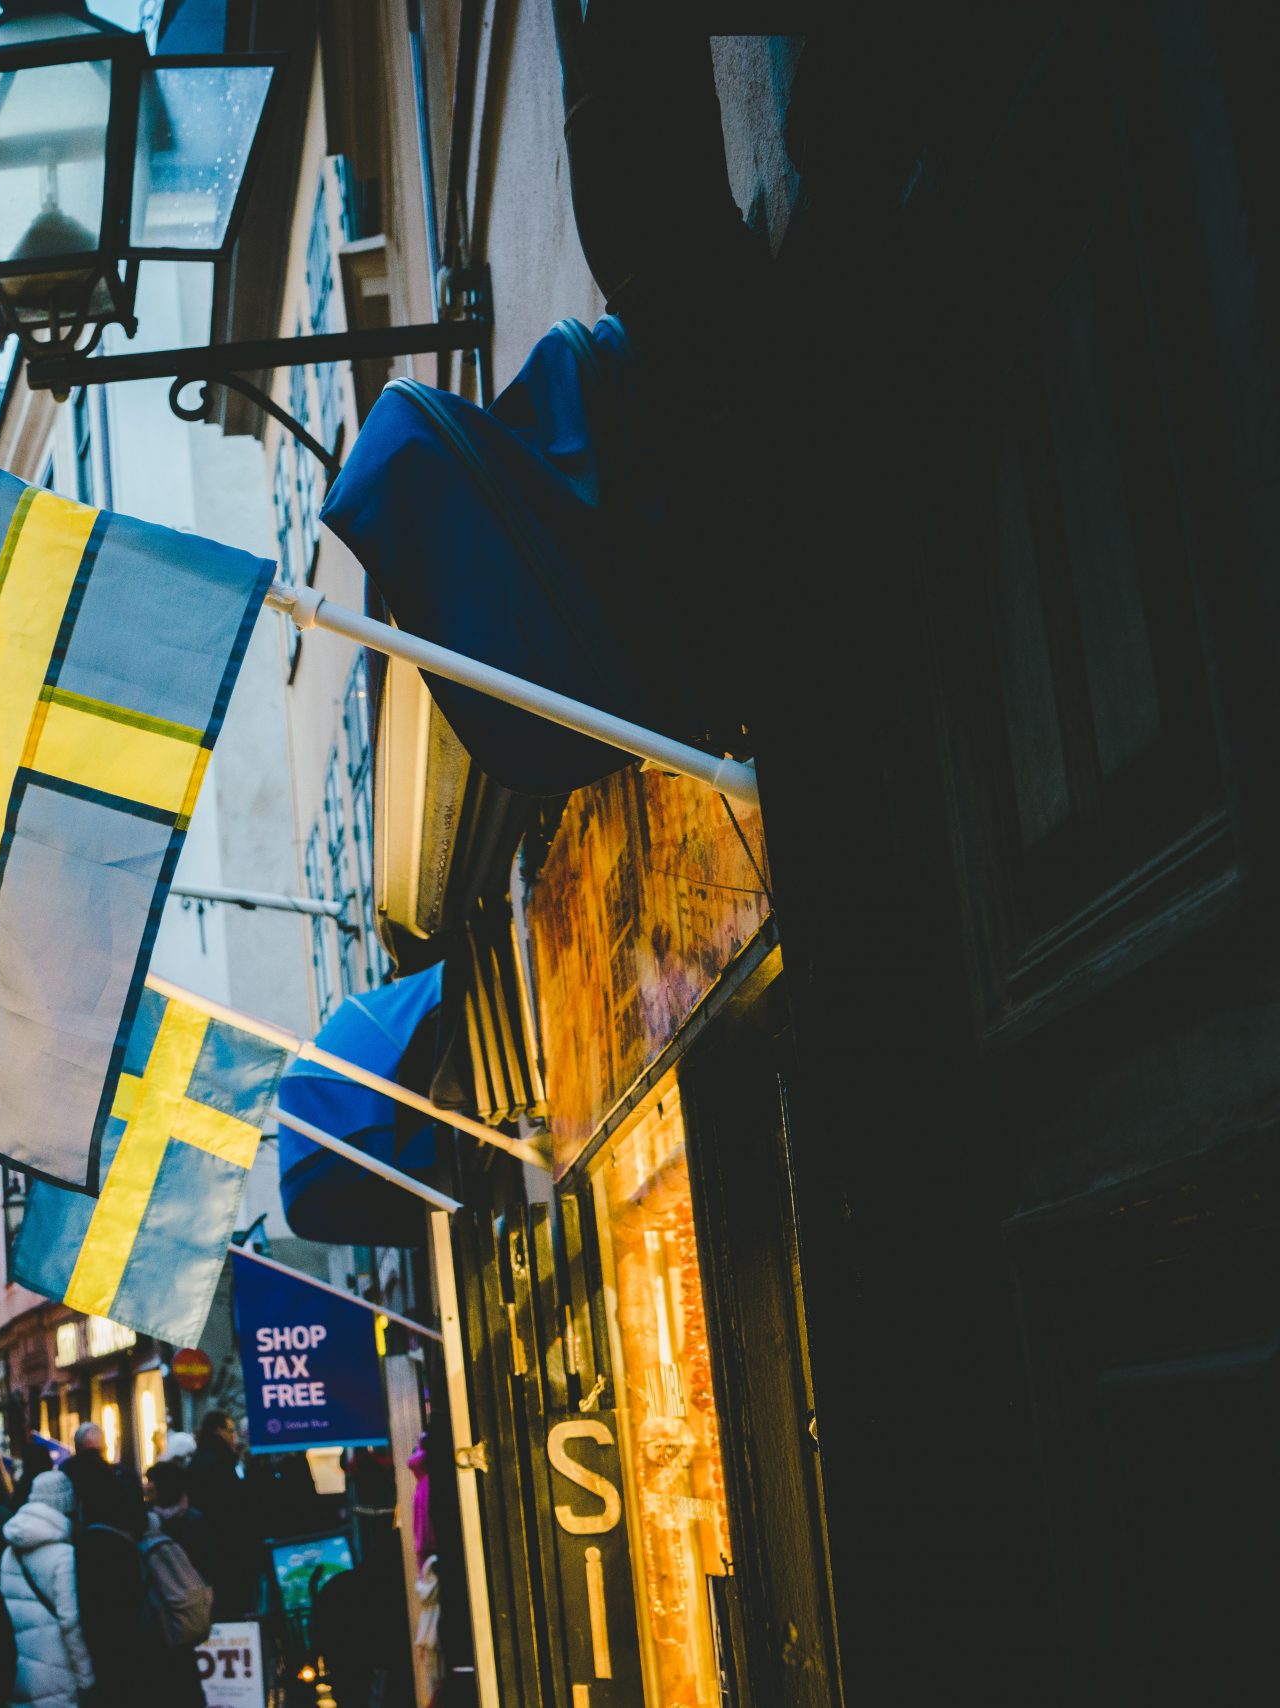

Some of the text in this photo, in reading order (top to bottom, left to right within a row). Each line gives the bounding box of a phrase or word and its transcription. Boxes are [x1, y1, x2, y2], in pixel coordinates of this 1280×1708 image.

[256, 1324, 327, 1352] SHOP
[258, 1354, 310, 1380] TAX
[261, 1381, 327, 1409] FREE
[547, 1419, 621, 1708] Si
